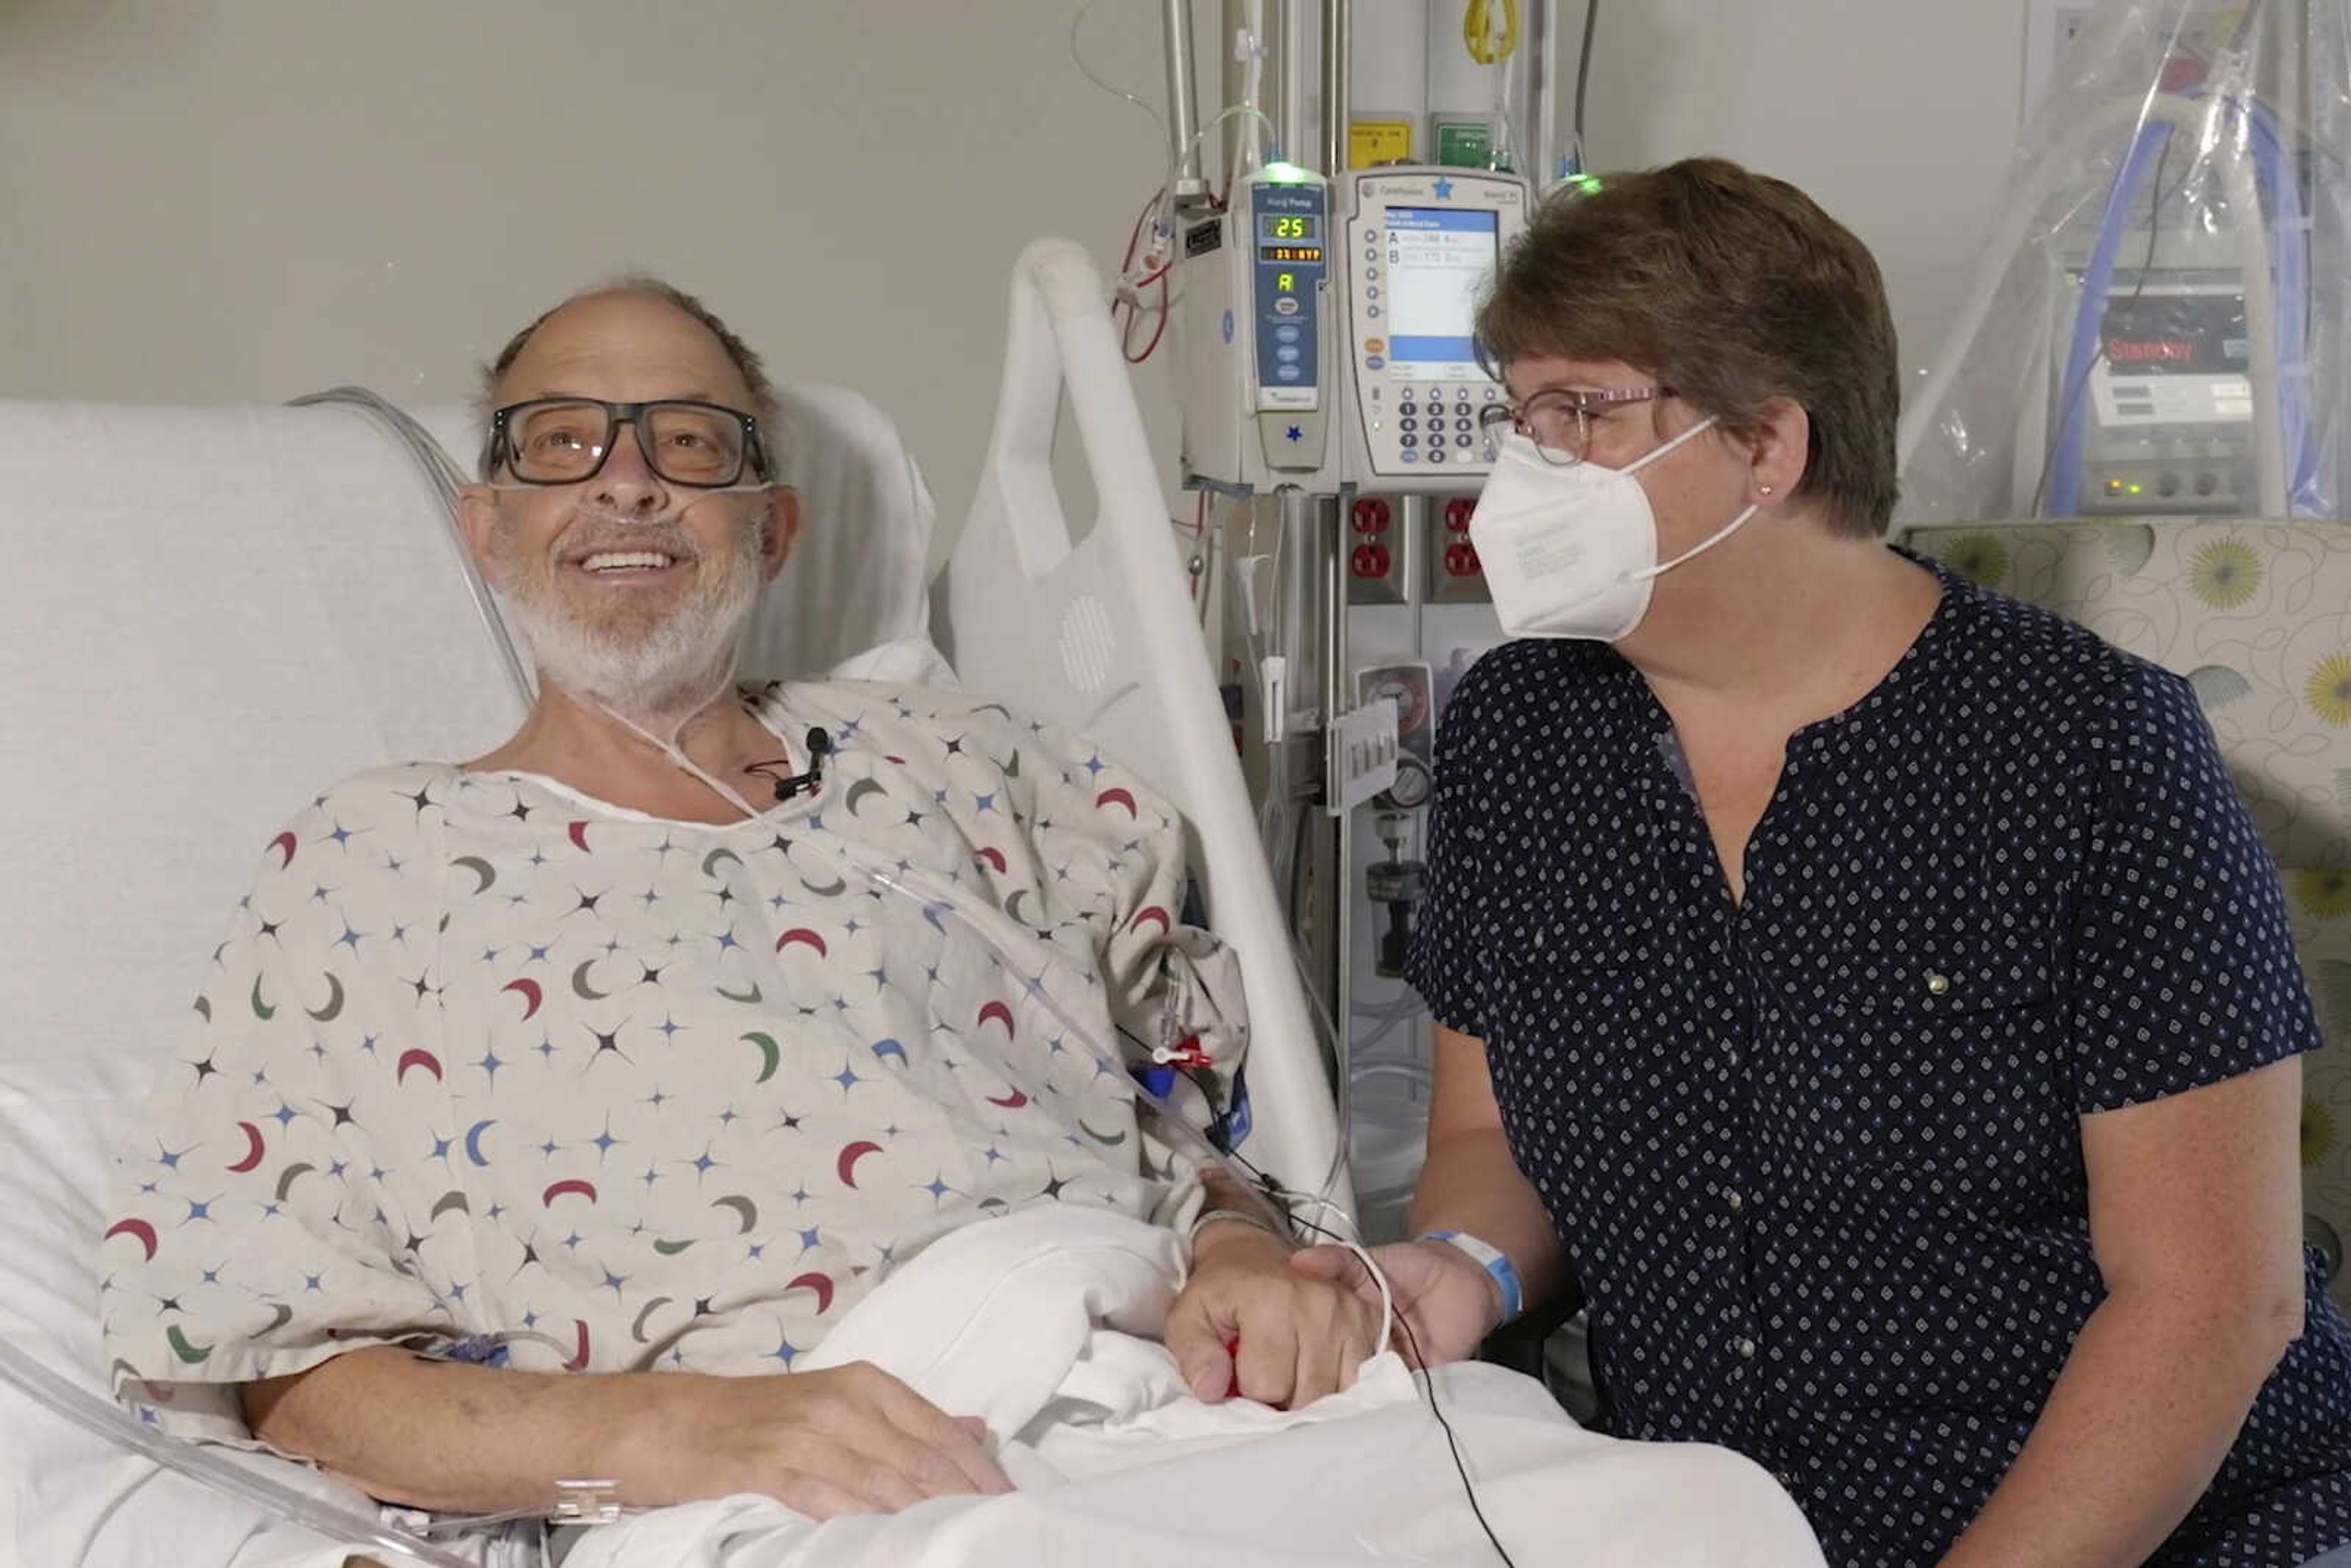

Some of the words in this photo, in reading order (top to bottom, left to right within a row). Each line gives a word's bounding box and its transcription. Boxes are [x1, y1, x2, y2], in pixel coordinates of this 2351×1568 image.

[1277, 217, 1302, 238] 25
[1389, 231, 1398, 244] A
[1389, 250, 1399, 263] B
[1278, 274, 1292, 291] A
